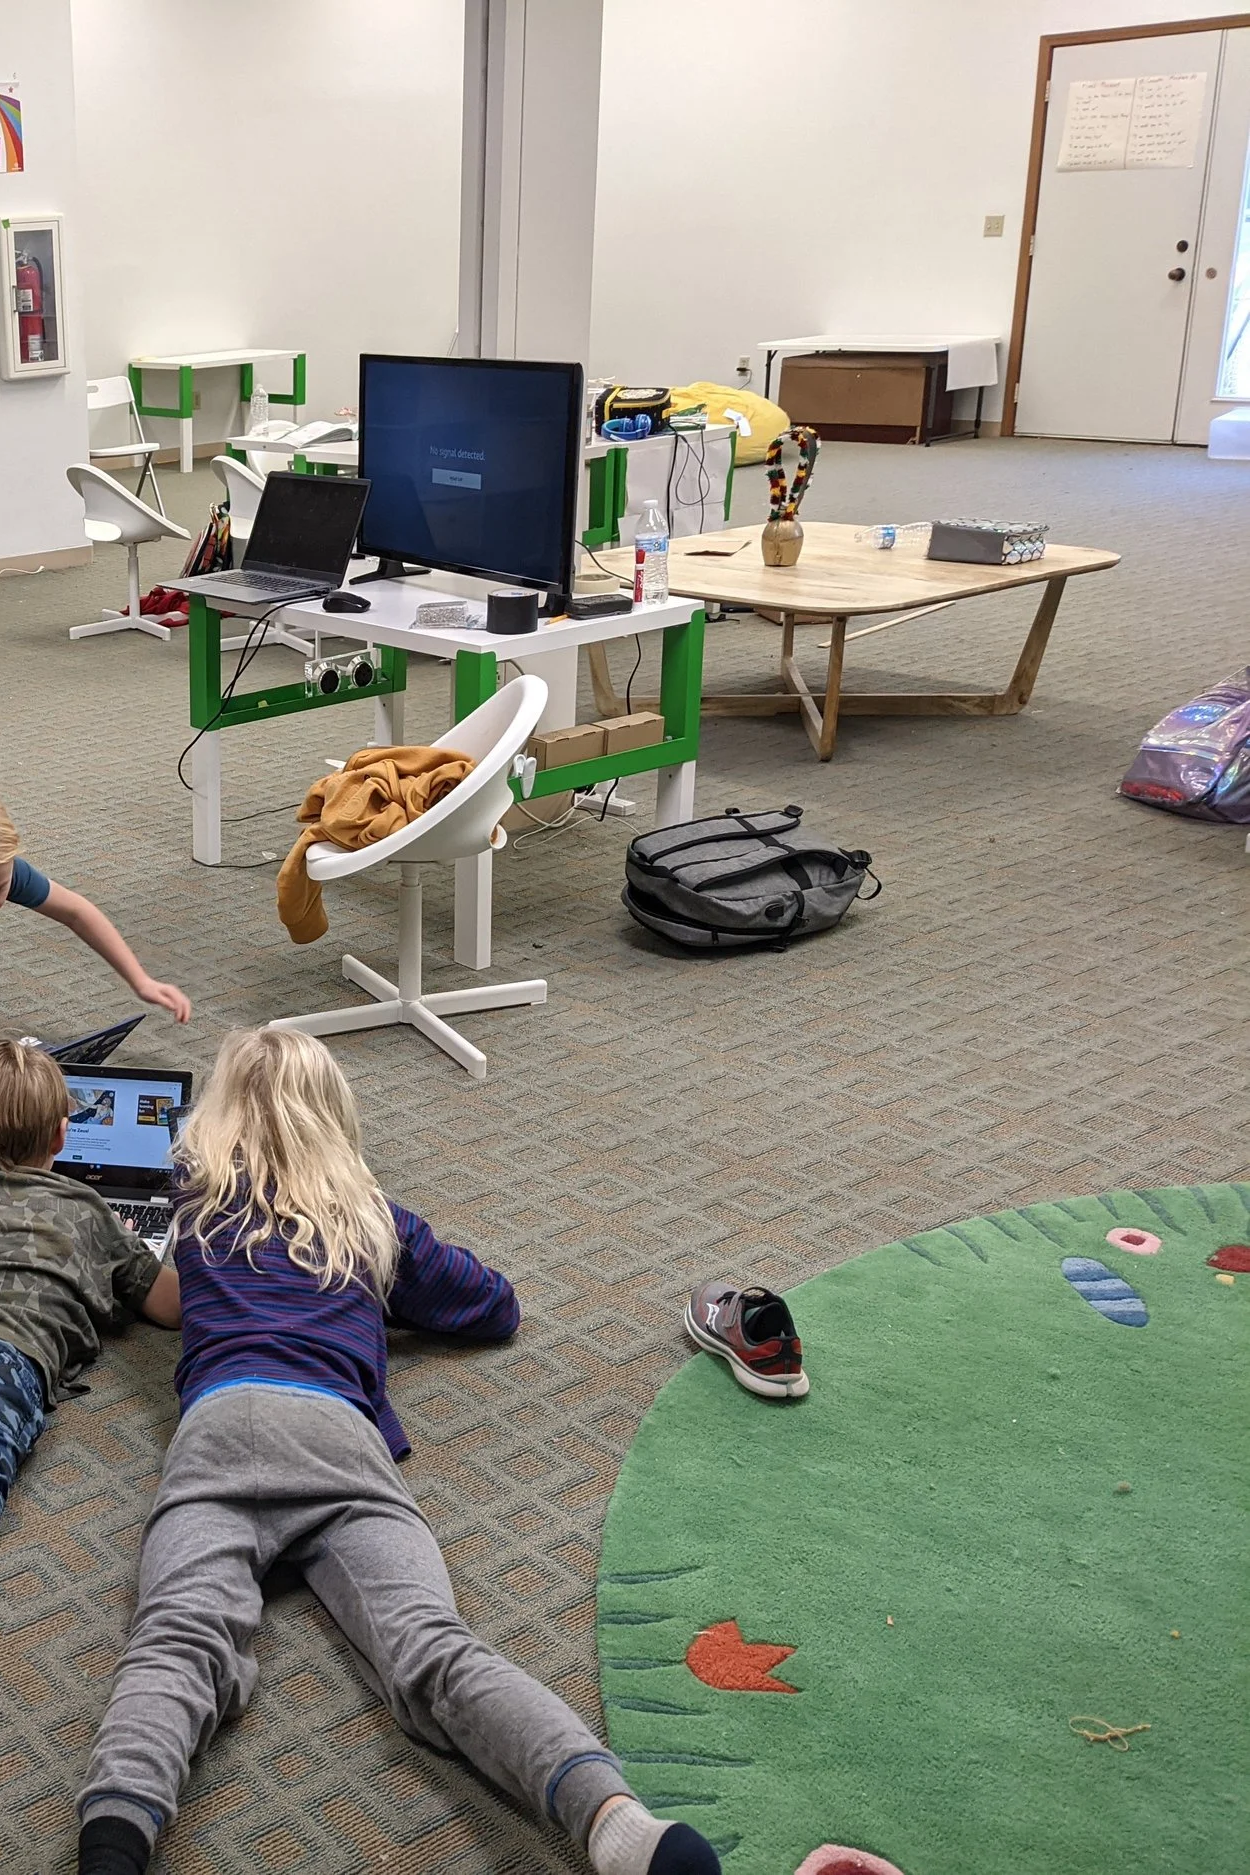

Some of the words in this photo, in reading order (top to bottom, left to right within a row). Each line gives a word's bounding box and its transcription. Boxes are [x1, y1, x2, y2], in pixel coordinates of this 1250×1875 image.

[430, 445, 438, 456] No
[439, 448, 456, 459] signal
[457, 450, 485, 461] detected.
[85, 1173, 103, 1181] acer
